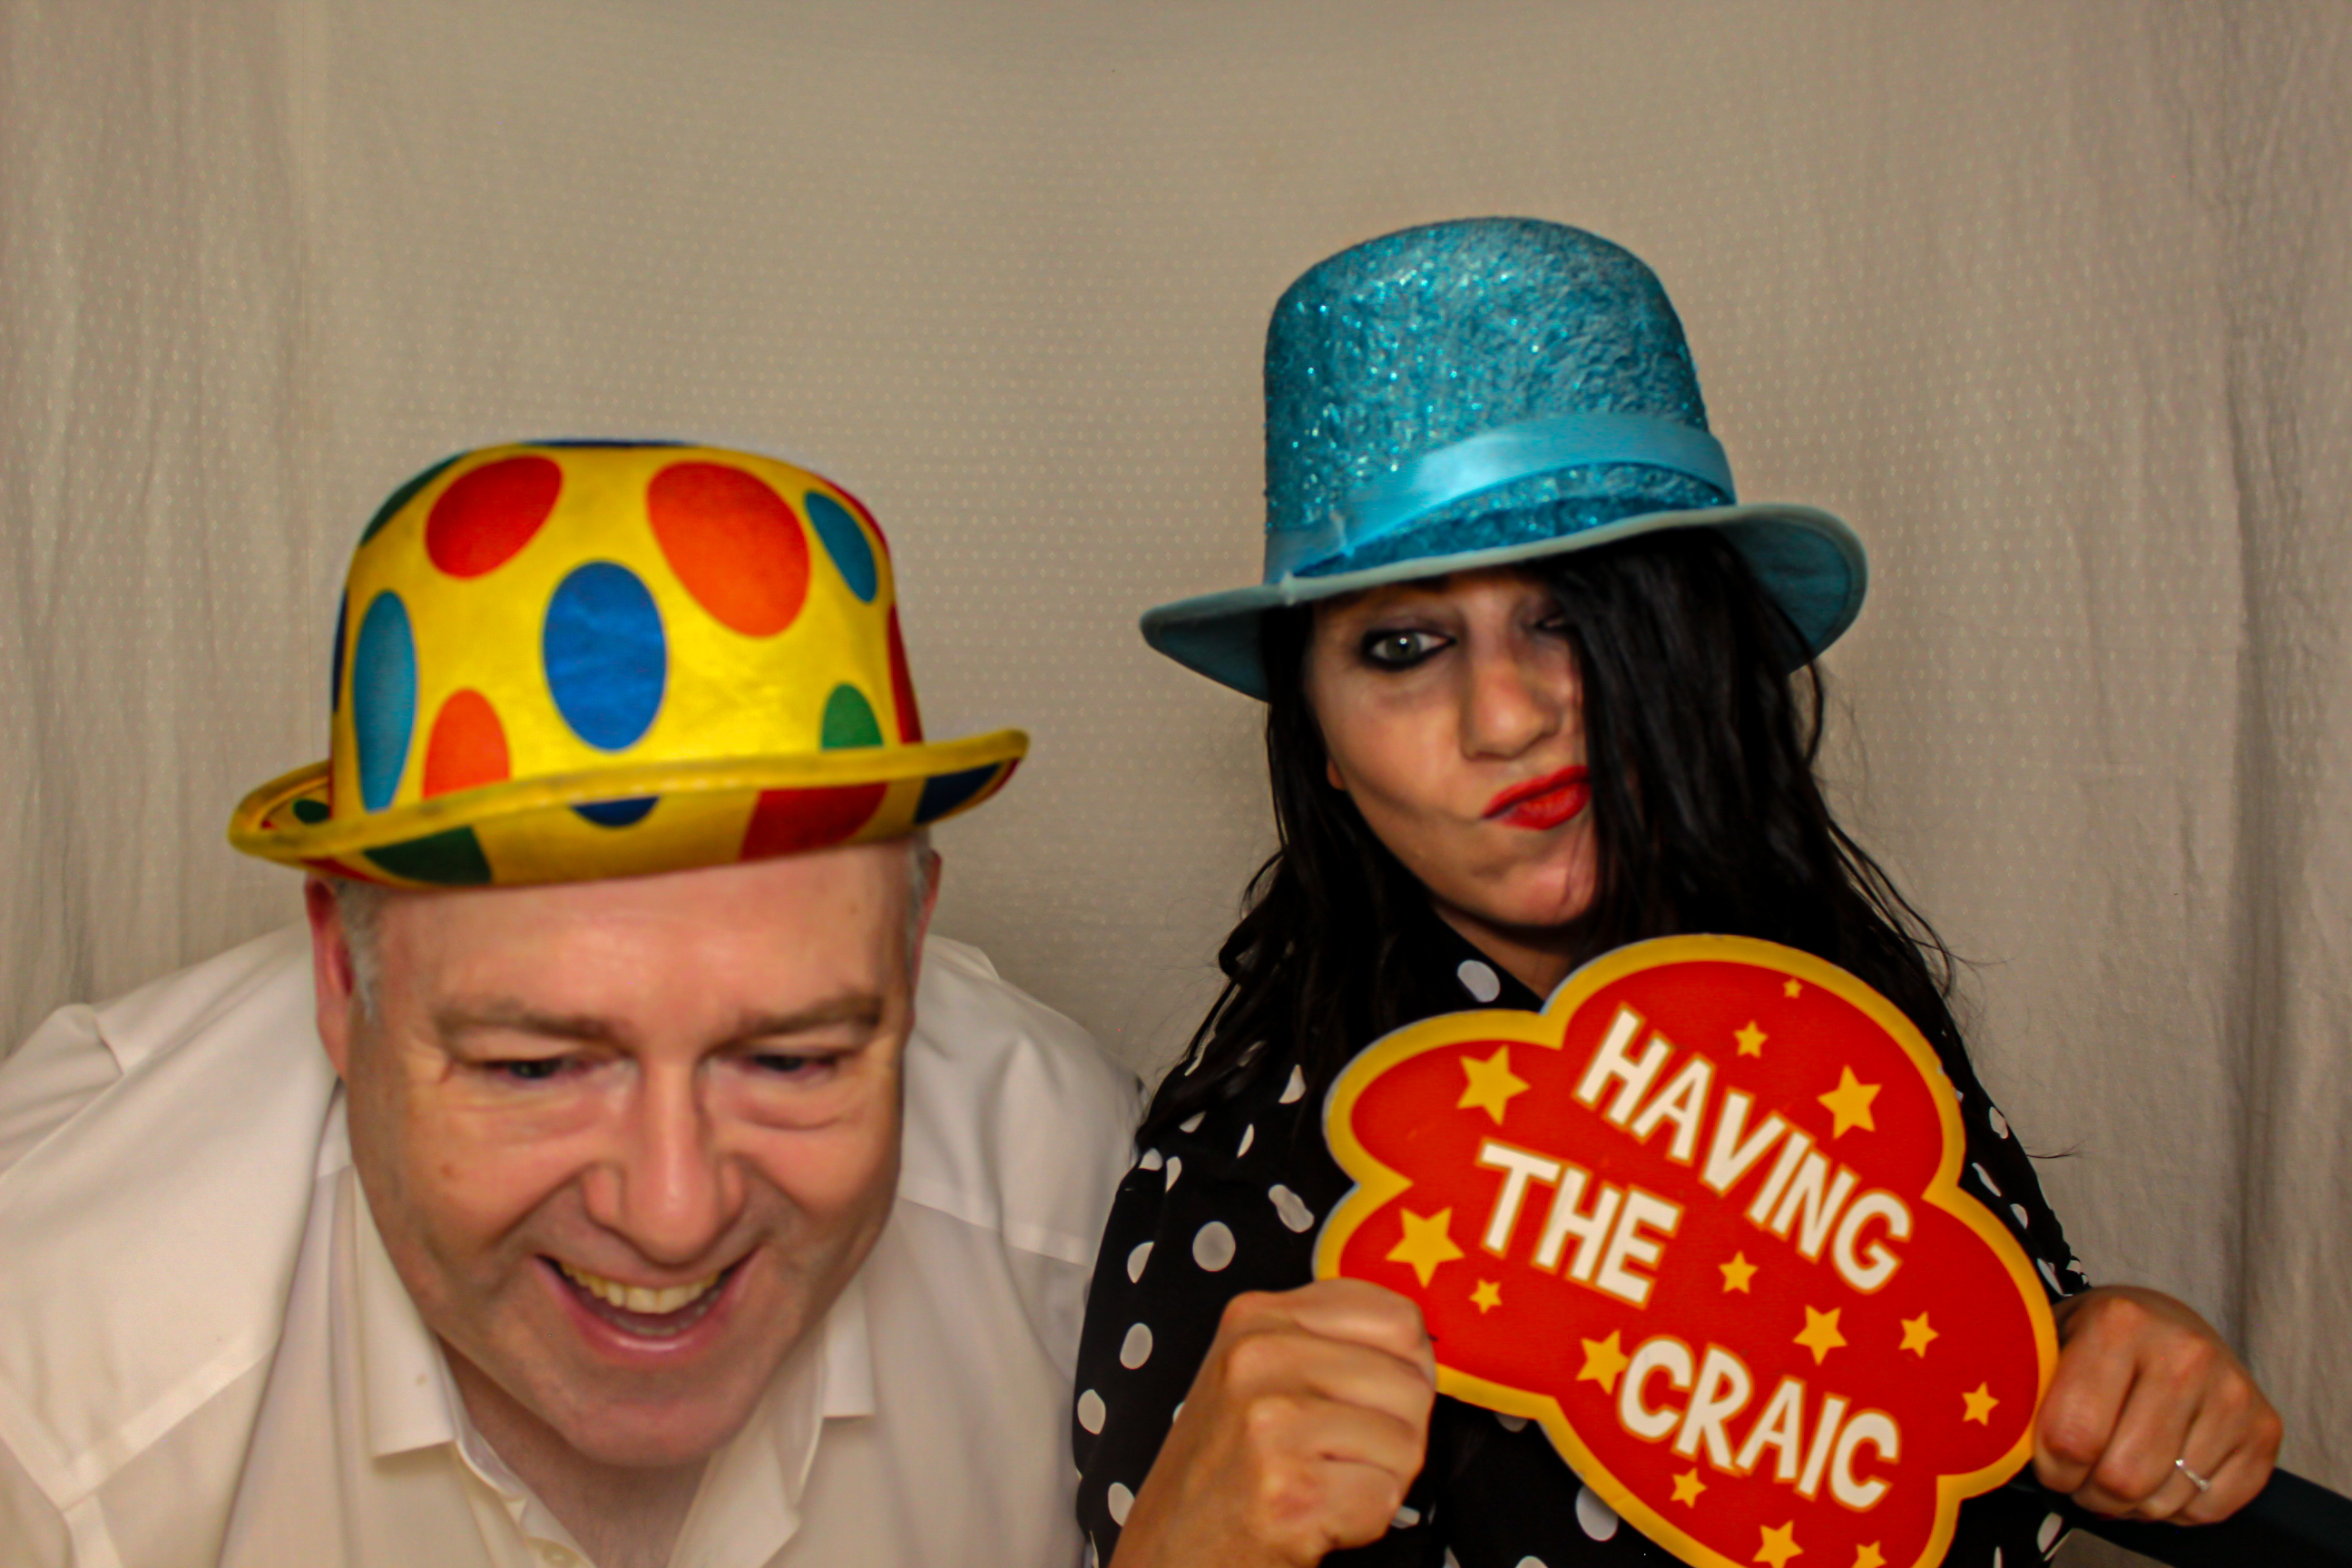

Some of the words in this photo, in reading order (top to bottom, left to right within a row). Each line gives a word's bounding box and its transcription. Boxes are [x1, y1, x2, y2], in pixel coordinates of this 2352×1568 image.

[1479, 1142, 1680, 1303] THE
[1578, 1009, 1910, 1290] HAVING
[1620, 1338, 1897, 1508] CRAIC
